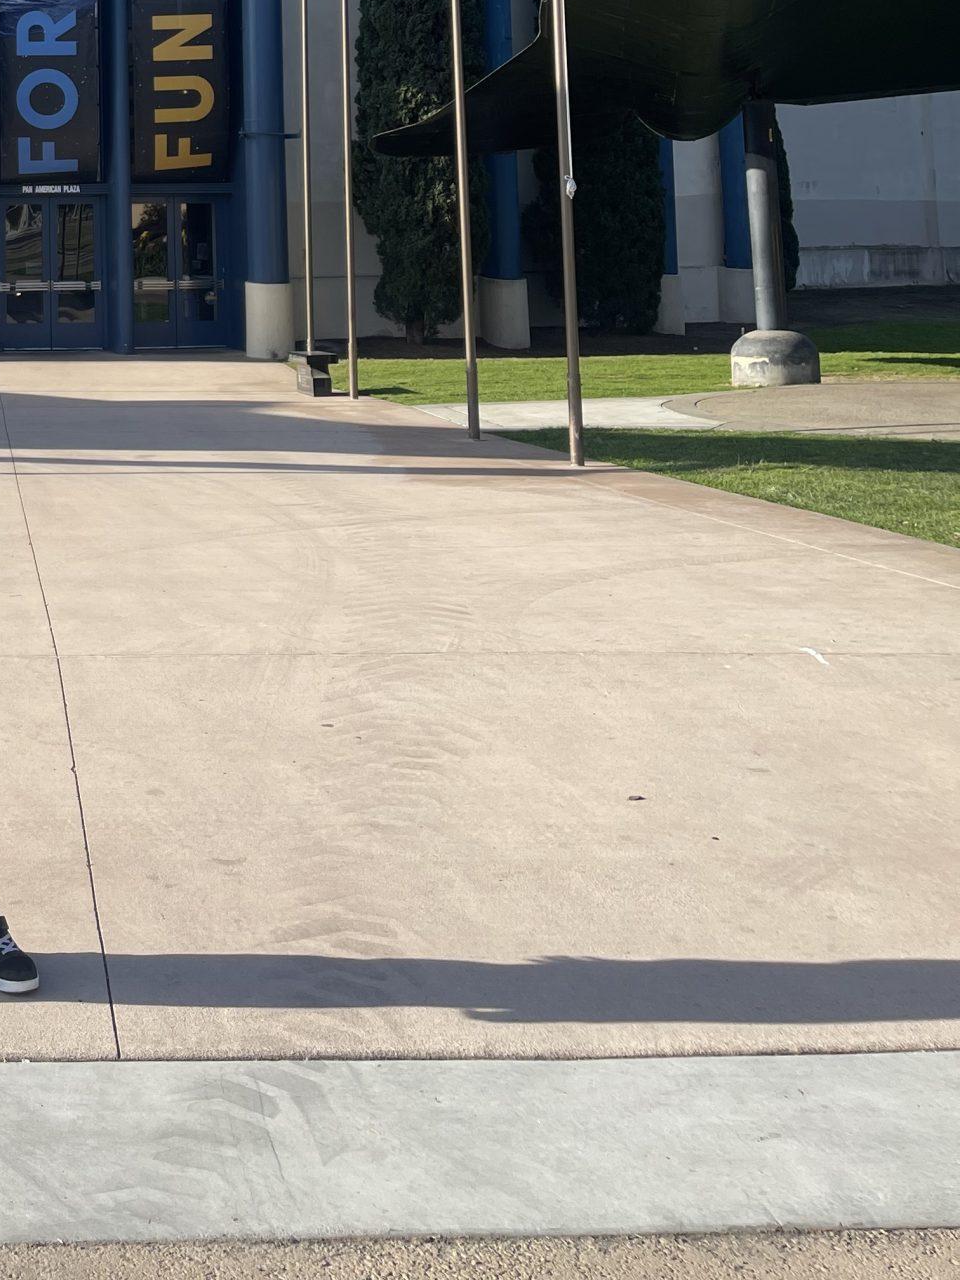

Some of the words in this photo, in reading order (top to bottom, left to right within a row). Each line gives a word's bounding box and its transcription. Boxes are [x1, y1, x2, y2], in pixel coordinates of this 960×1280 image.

[16, 9, 79, 175] FOR
[151, 13, 215, 171] FUN
[22, 185, 33, 194] PAN
[35, 185, 61, 194] AMERICAN
[63, 185, 81, 193] PLAZA
